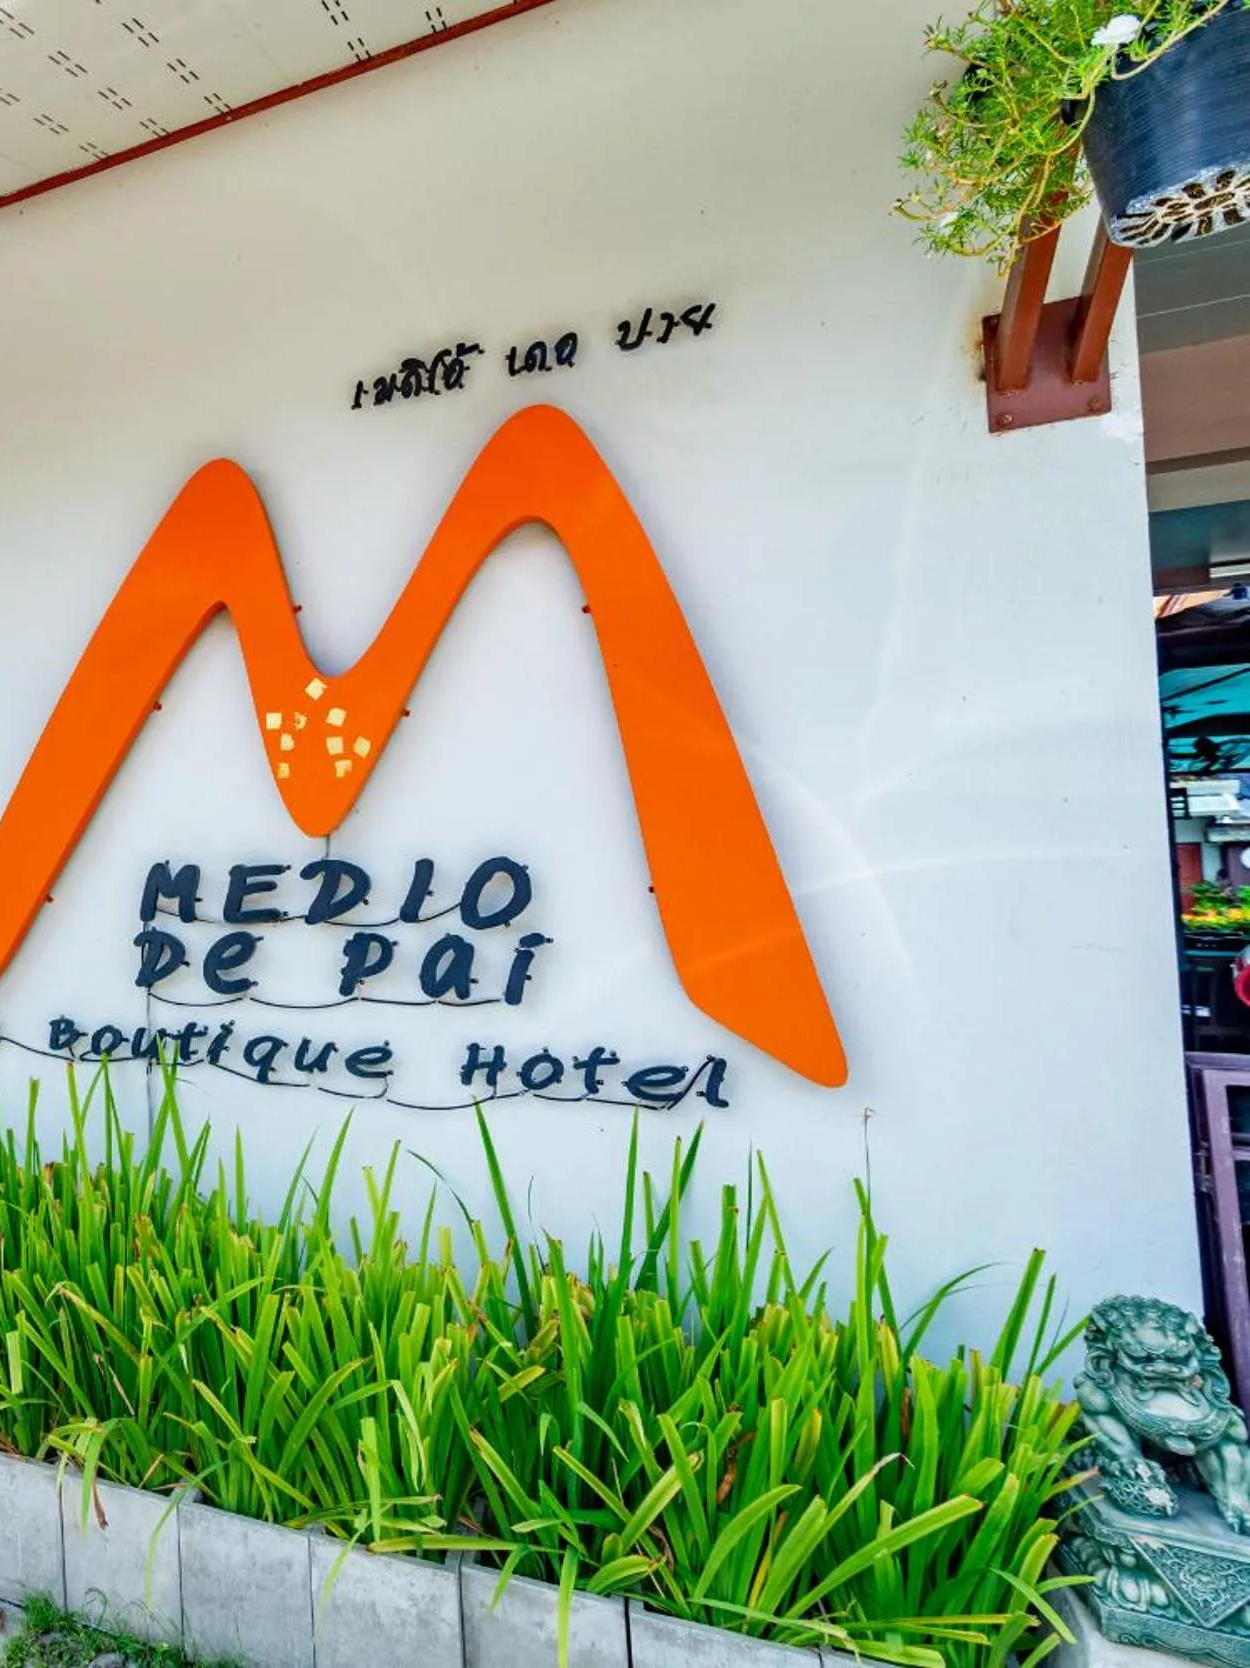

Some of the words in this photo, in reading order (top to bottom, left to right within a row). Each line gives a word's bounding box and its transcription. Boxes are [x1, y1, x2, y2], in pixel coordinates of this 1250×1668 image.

[505, 331, 578, 376] เดอ
[615, 302, 716, 351] ปาย
[139, 857, 532, 926] MEDIO
[49, 1018, 392, 1085] Boutique
[461, 1042, 729, 1108] Hotel
